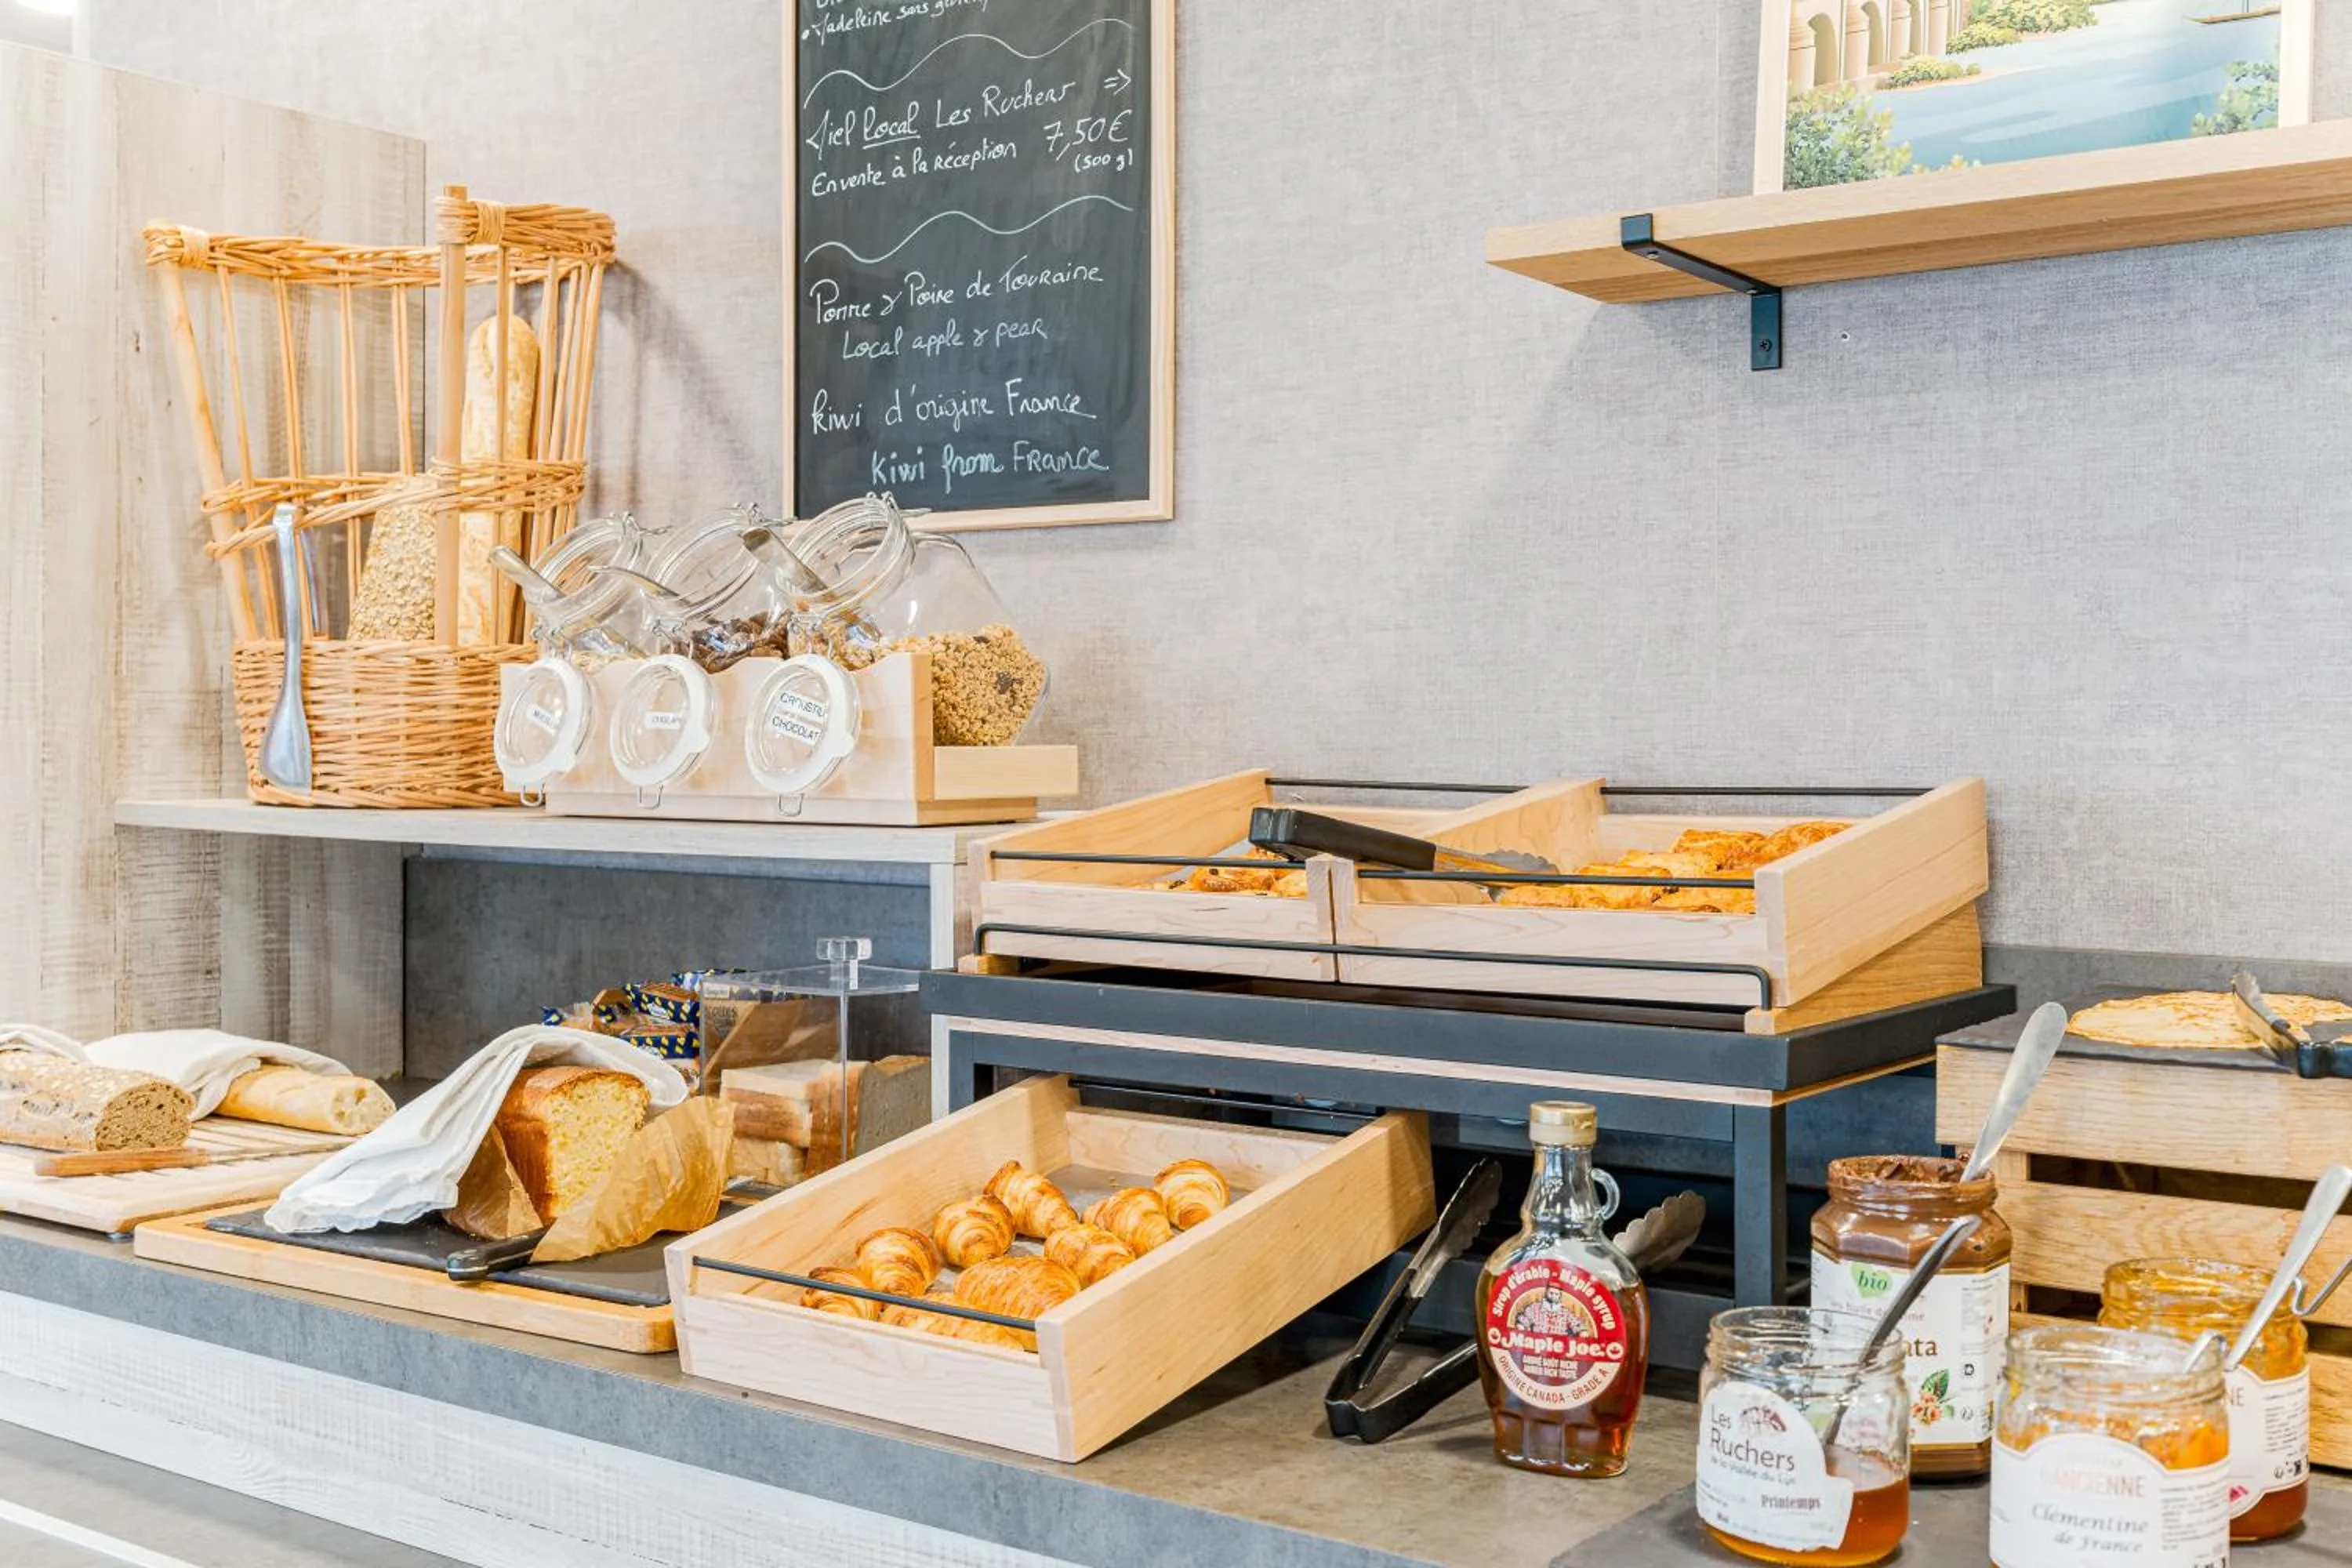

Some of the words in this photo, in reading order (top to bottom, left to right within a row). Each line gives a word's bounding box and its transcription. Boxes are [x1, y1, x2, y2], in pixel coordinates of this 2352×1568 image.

[864, 100, 920, 142] local
[936, 99, 972, 128] Les
[982, 78, 1076, 118] Ruchers
[1043, 109, 1133, 162] 7,50€
[891, 155, 906, 179] à
[913, 147, 929, 175] la
[904, 270, 954, 307] Poire
[966, 269, 992, 299] de
[998, 255, 1104, 293] Touraine
[842, 325, 903, 361] Local
[912, 318, 965, 358] apple
[996, 318, 1048, 347] pear
[1005, 377, 1098, 419] France
[941, 442, 1004, 495] from
[1013, 440, 1109, 473] France
[1559, 1268, 1596, 1298] Maple
[1857, 1270, 1889, 1292] bio
[1501, 1331, 1565, 1354] Maple
[1498, 1355, 1526, 1392] ORIGINE
[1526, 1387, 1566, 1404] CANADA
[1572, 1377, 1603, 1400] GRADE
[1710, 1403, 1732, 1430] Les
[1709, 1427, 1795, 1472] Ruchers
[1761, 1494, 1822, 1511] Printemps
[2031, 1503, 2150, 1534] Clémentine
[2053, 1530, 2074, 1545] de
